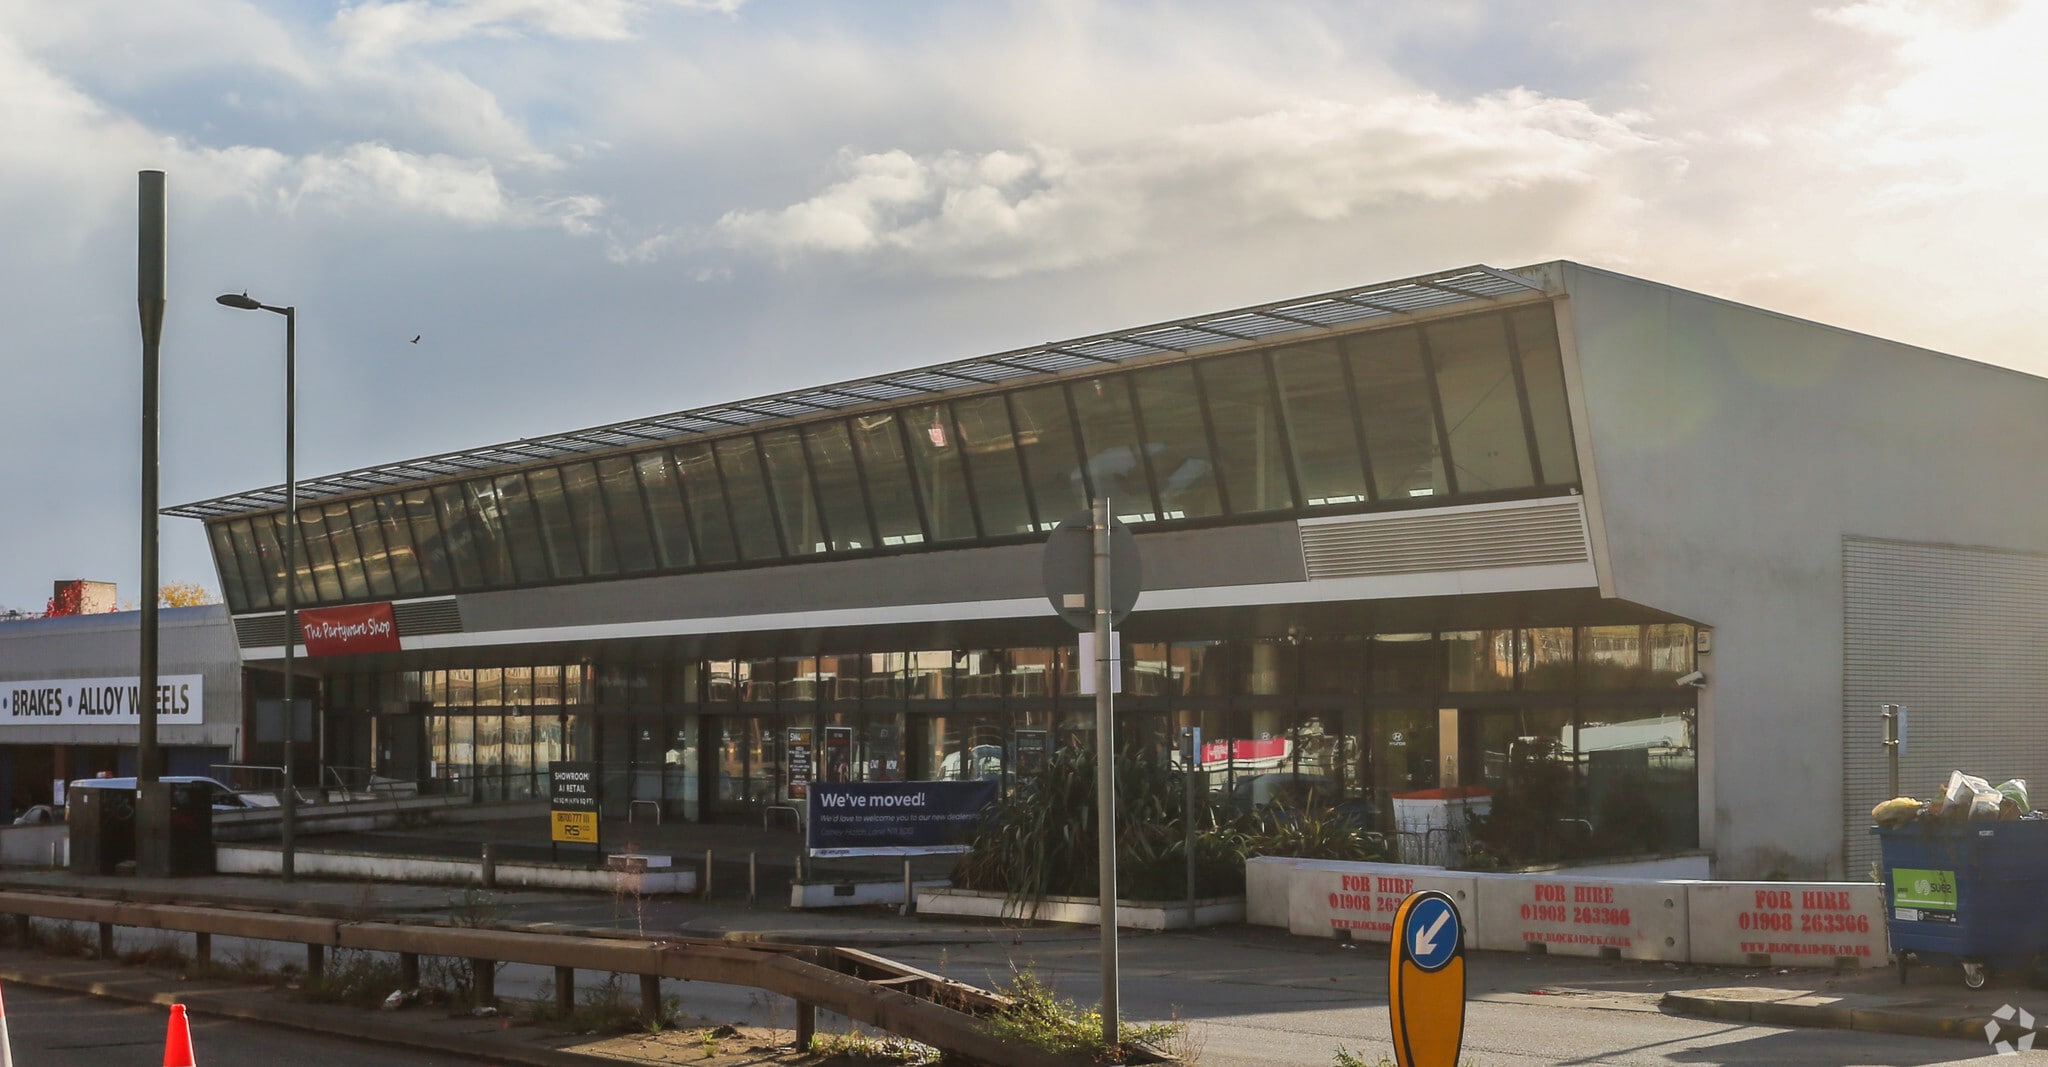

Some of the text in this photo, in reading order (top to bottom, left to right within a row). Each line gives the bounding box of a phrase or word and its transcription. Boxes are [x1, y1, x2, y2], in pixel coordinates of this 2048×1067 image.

[305, 618, 390, 641] The Partyware Shop
[12, 684, 189, 716] BRAKES ALLOY WEELS
[566, 785, 586, 793] RETAIL
[820, 792, 926, 807] We've moved!
[840, 814, 855, 822] love
[863, 813, 895, 822] welcome
[896, 815, 910, 824] you
[1342, 875, 1413, 894] FOR HIRE
[1535, 884, 1613, 904] FOR HIRE
[1329, 893, 1370, 912] 01908
[1755, 890, 1850, 910] FOR HIRE
[1521, 904, 1630, 926] 01908 263366
[1739, 911, 1870, 933] 01908 263366
[1522, 931, 1631, 947] WWW.BLOCKAID-UK.CO.UK
[1740, 942, 1871, 957] WWW.BLOCKAID-UK.CO.UK
